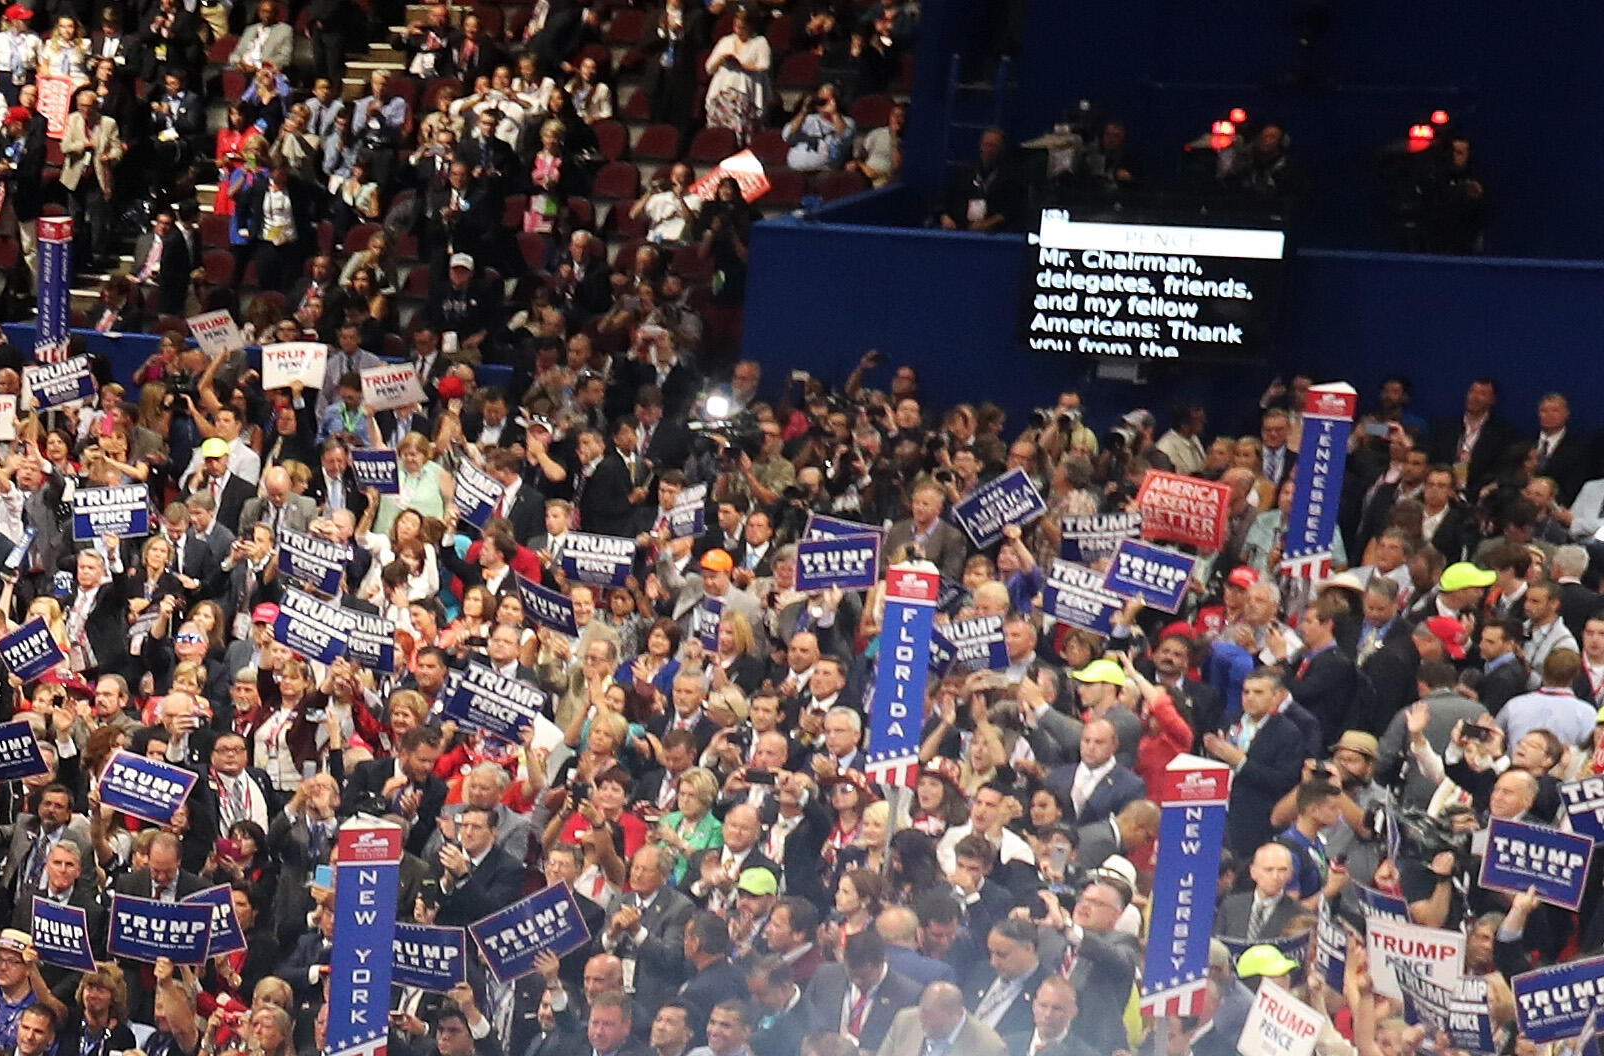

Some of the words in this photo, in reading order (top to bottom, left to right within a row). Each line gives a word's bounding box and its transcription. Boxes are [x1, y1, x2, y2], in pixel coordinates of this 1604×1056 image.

[1039, 247, 1075, 267] Mr.
[1081, 250, 1203, 275] Chairman,
[1036, 269, 1157, 294] delegates,
[1163, 274, 1253, 300] friends,
[1034, 292, 1078, 310] and
[1084, 297, 1121, 318] my
[1127, 295, 1198, 318] fellow
[192, 316, 230, 332] TRUMP
[1030, 312, 1160, 338] Americans:
[1167, 320, 1243, 344] Thank
[1029, 337, 1071, 352] you
[1078, 337, 1133, 356] from
[1139, 340, 1179, 358] the
[28, 357, 88, 382] TRUMP
[365, 372, 414, 387] TRUMP
[44, 379, 80, 396] PENCE
[376, 386, 407, 395] PENCE
[353, 460, 395, 473] TRUMP
[75, 487, 146, 505] TRUMP
[1150, 477, 1219, 503] AMERICA
[1305, 422, 1334, 543] TENNESSEE
[90, 511, 131, 524] PENCE
[967, 485, 1035, 530] AMERICA
[1147, 492, 1218, 517] DESERVES
[1063, 514, 1142, 531] TRUMP
[1144, 507, 1216, 534] BETTER
[281, 529, 345, 561] TRUMP
[564, 533, 635, 554] TRUMP
[800, 549, 873, 565] TRUMP
[291, 553, 327, 578] PENCE
[1119, 552, 1187, 583] TRUMP
[285, 589, 352, 631] TRUMP
[520, 586, 571, 616] TRUMP
[1056, 592, 1104, 617] PENCE
[4, 630, 49, 661] TRUMP
[288, 621, 330, 649] PENCE
[468, 664, 545, 709] TRUMP
[887, 608, 917, 738] FLORIDA
[470, 694, 519, 723] PENCE
[113, 763, 184, 796] TRUMP
[113, 776, 172, 804] PENCE
[1180, 807, 1203, 855] NEW
[1494, 836, 1584, 869] TRUMP
[1499, 854, 1573, 879] PENCE
[354, 870, 377, 925] NEW
[34, 916, 83, 940] TRUMP
[117, 911, 205, 935] TRUMP
[123, 927, 195, 944] PENCE
[485, 900, 570, 949] TRUMP
[1170, 874, 1194, 970] JERSEY
[35, 931, 81, 949] PENCE
[498, 917, 568, 957] PENCE
[1370, 932, 1456, 961] TRUMP
[1385, 954, 1433, 976] PENCE
[350, 949, 372, 1025] YORK
[1257, 992, 1316, 1038] TRUMP
[1259, 1021, 1293, 1050] PENCE
